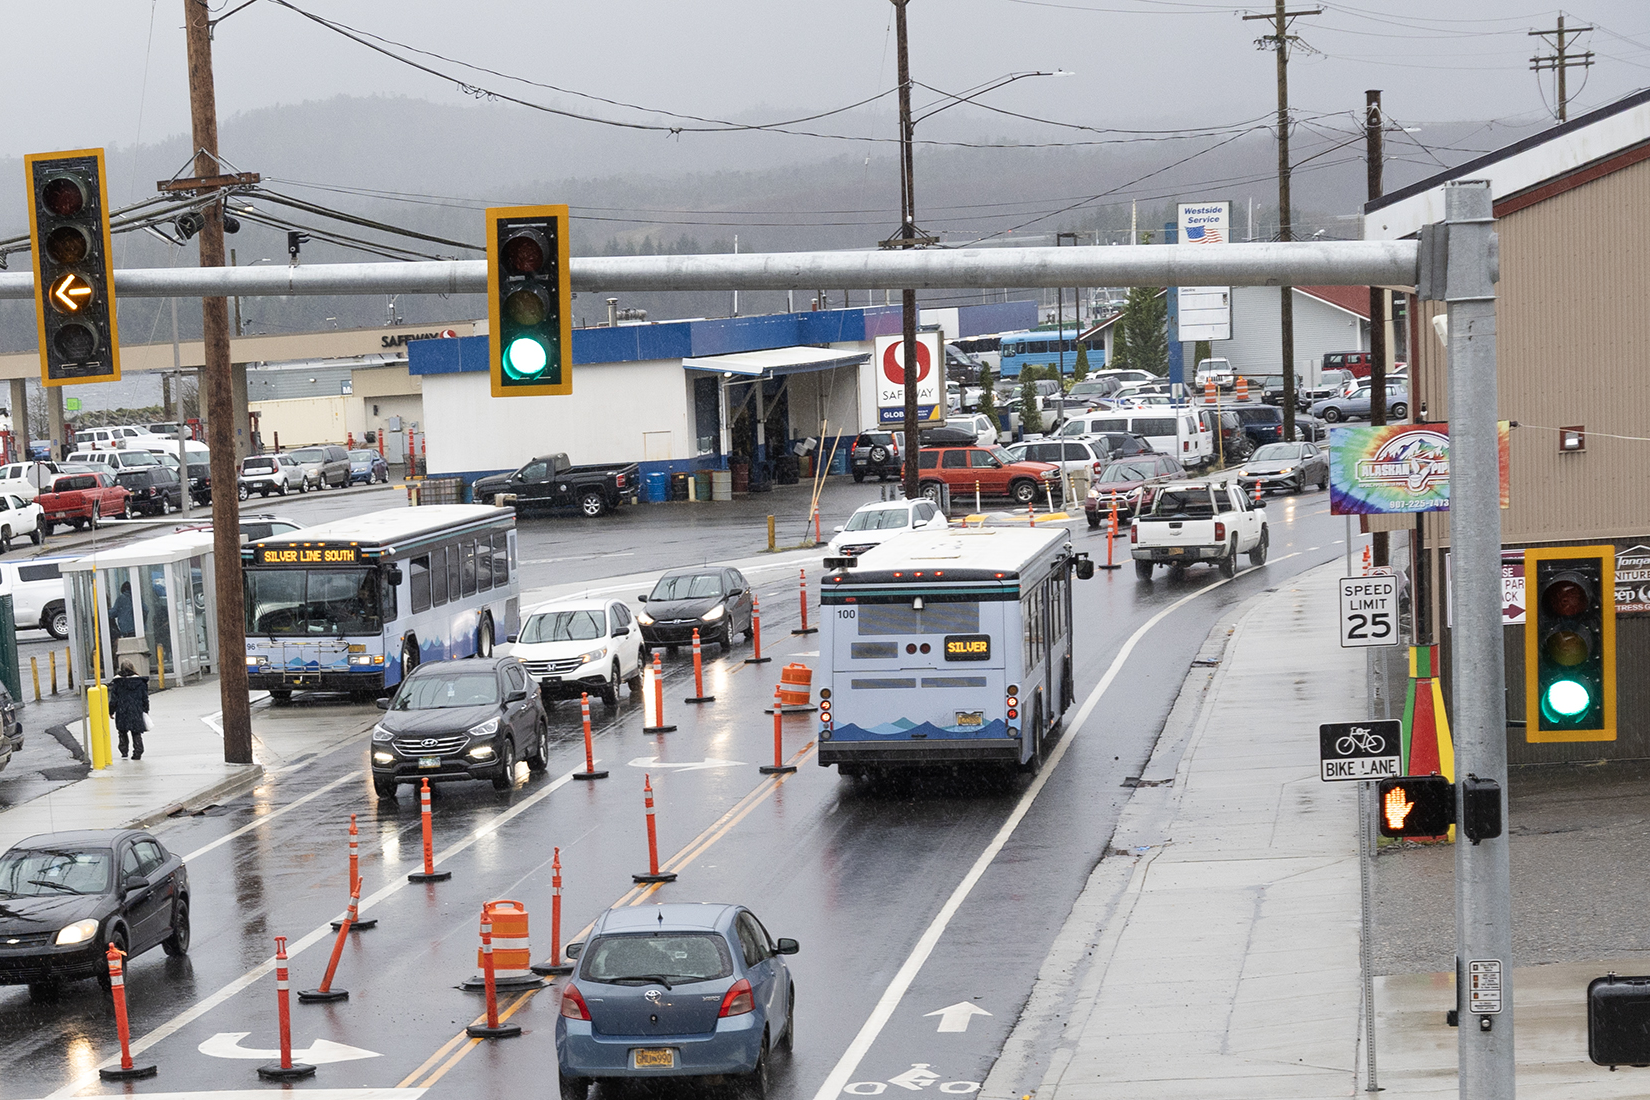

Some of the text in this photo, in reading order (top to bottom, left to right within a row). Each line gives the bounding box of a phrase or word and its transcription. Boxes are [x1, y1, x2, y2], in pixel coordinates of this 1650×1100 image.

[1184, 206, 1222, 215] Westside
[1187, 215, 1220, 224] Service
[883, 388, 934, 401] SAFAY
[883, 411, 906, 419] GLOB
[1361, 463, 1410, 477] ALASKAN
[264, 549, 355, 562] SILVER LINE SOUTH
[1615, 570, 1650, 581] NITURE
[1344, 583, 1393, 597] SPEED
[1505, 579, 1525, 590] PAR
[1350, 598, 1388, 611] LIMIT
[1614, 603, 1644, 612] TRESS
[837, 609, 856, 619] 100
[1347, 612, 1392, 640] 25
[947, 641, 988, 653] SILVER
[1325, 759, 1396, 777] BIKE LANE
